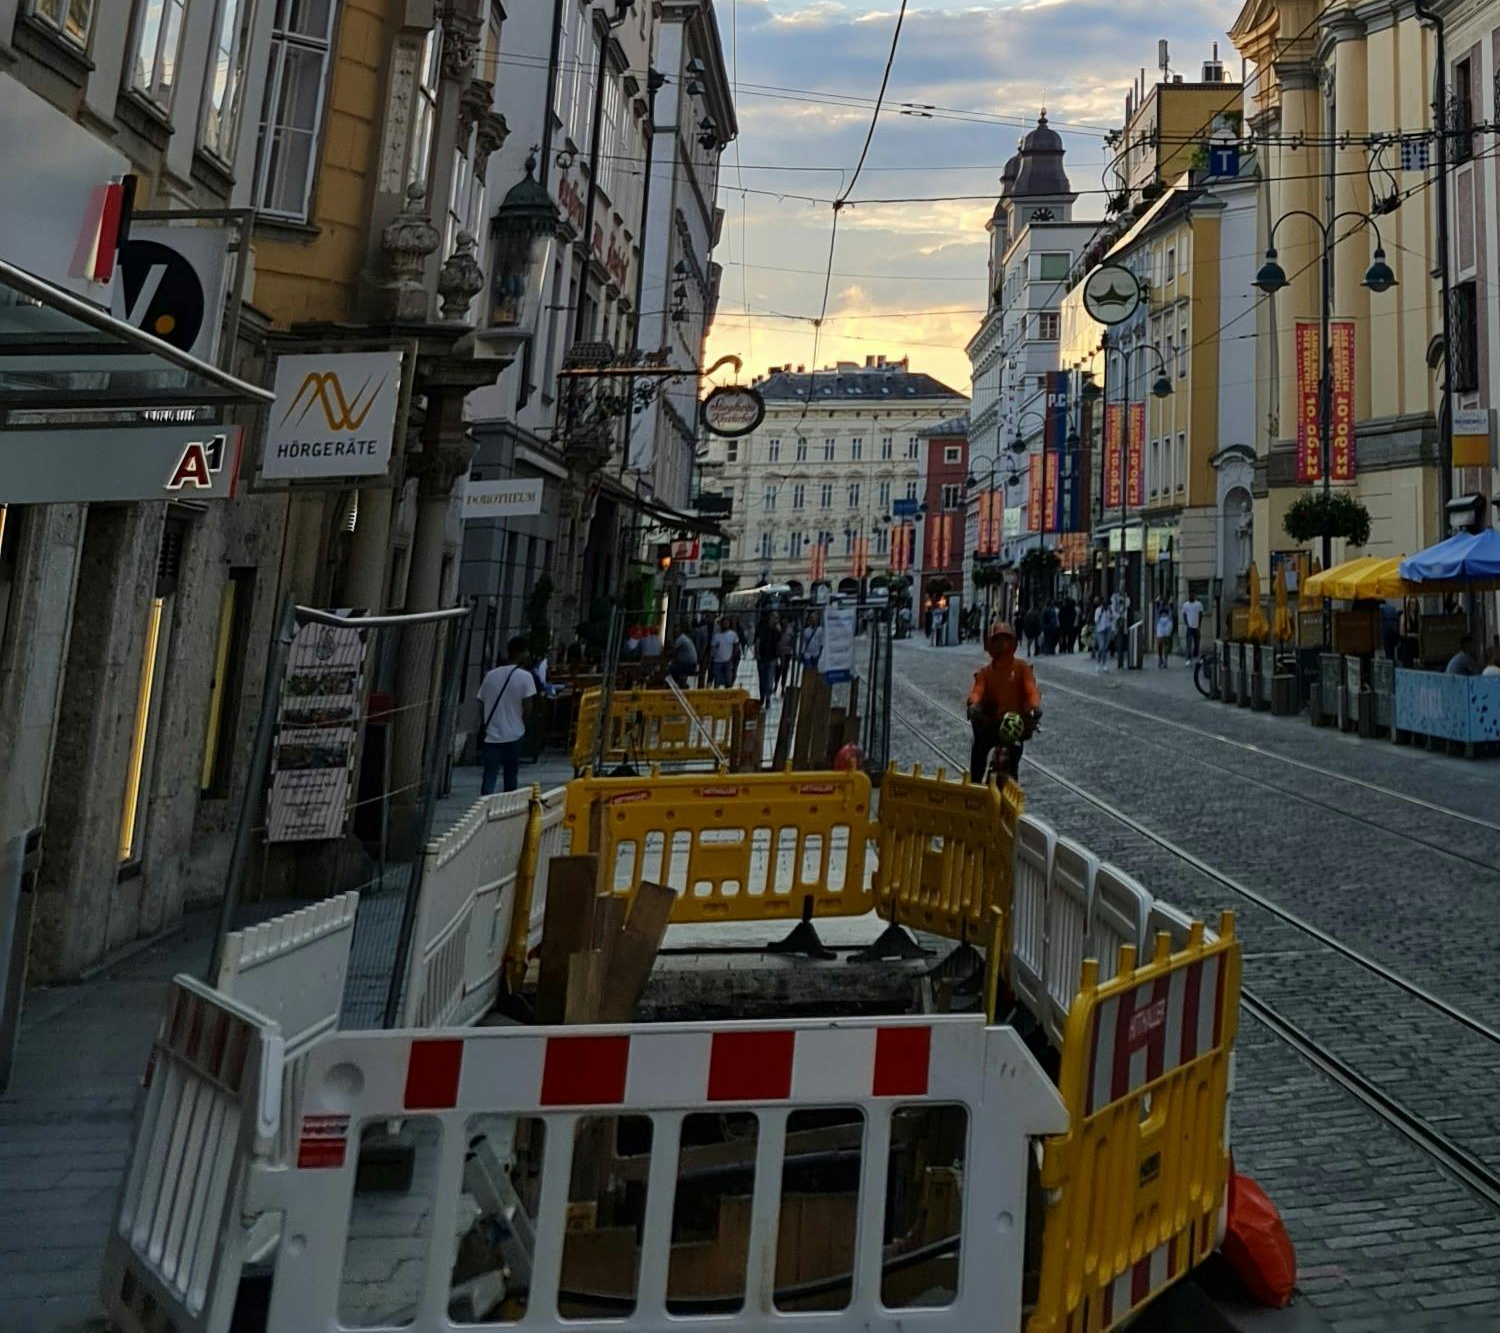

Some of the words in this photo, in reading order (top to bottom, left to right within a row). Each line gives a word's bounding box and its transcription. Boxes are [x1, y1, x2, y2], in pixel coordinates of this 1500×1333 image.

[1216, 150, 1233, 172] T
[276, 437, 378, 459] HÖRGERÄTE
[1305, 396, 1320, 477] 10.06.22
[166, 434, 227, 491] A1
